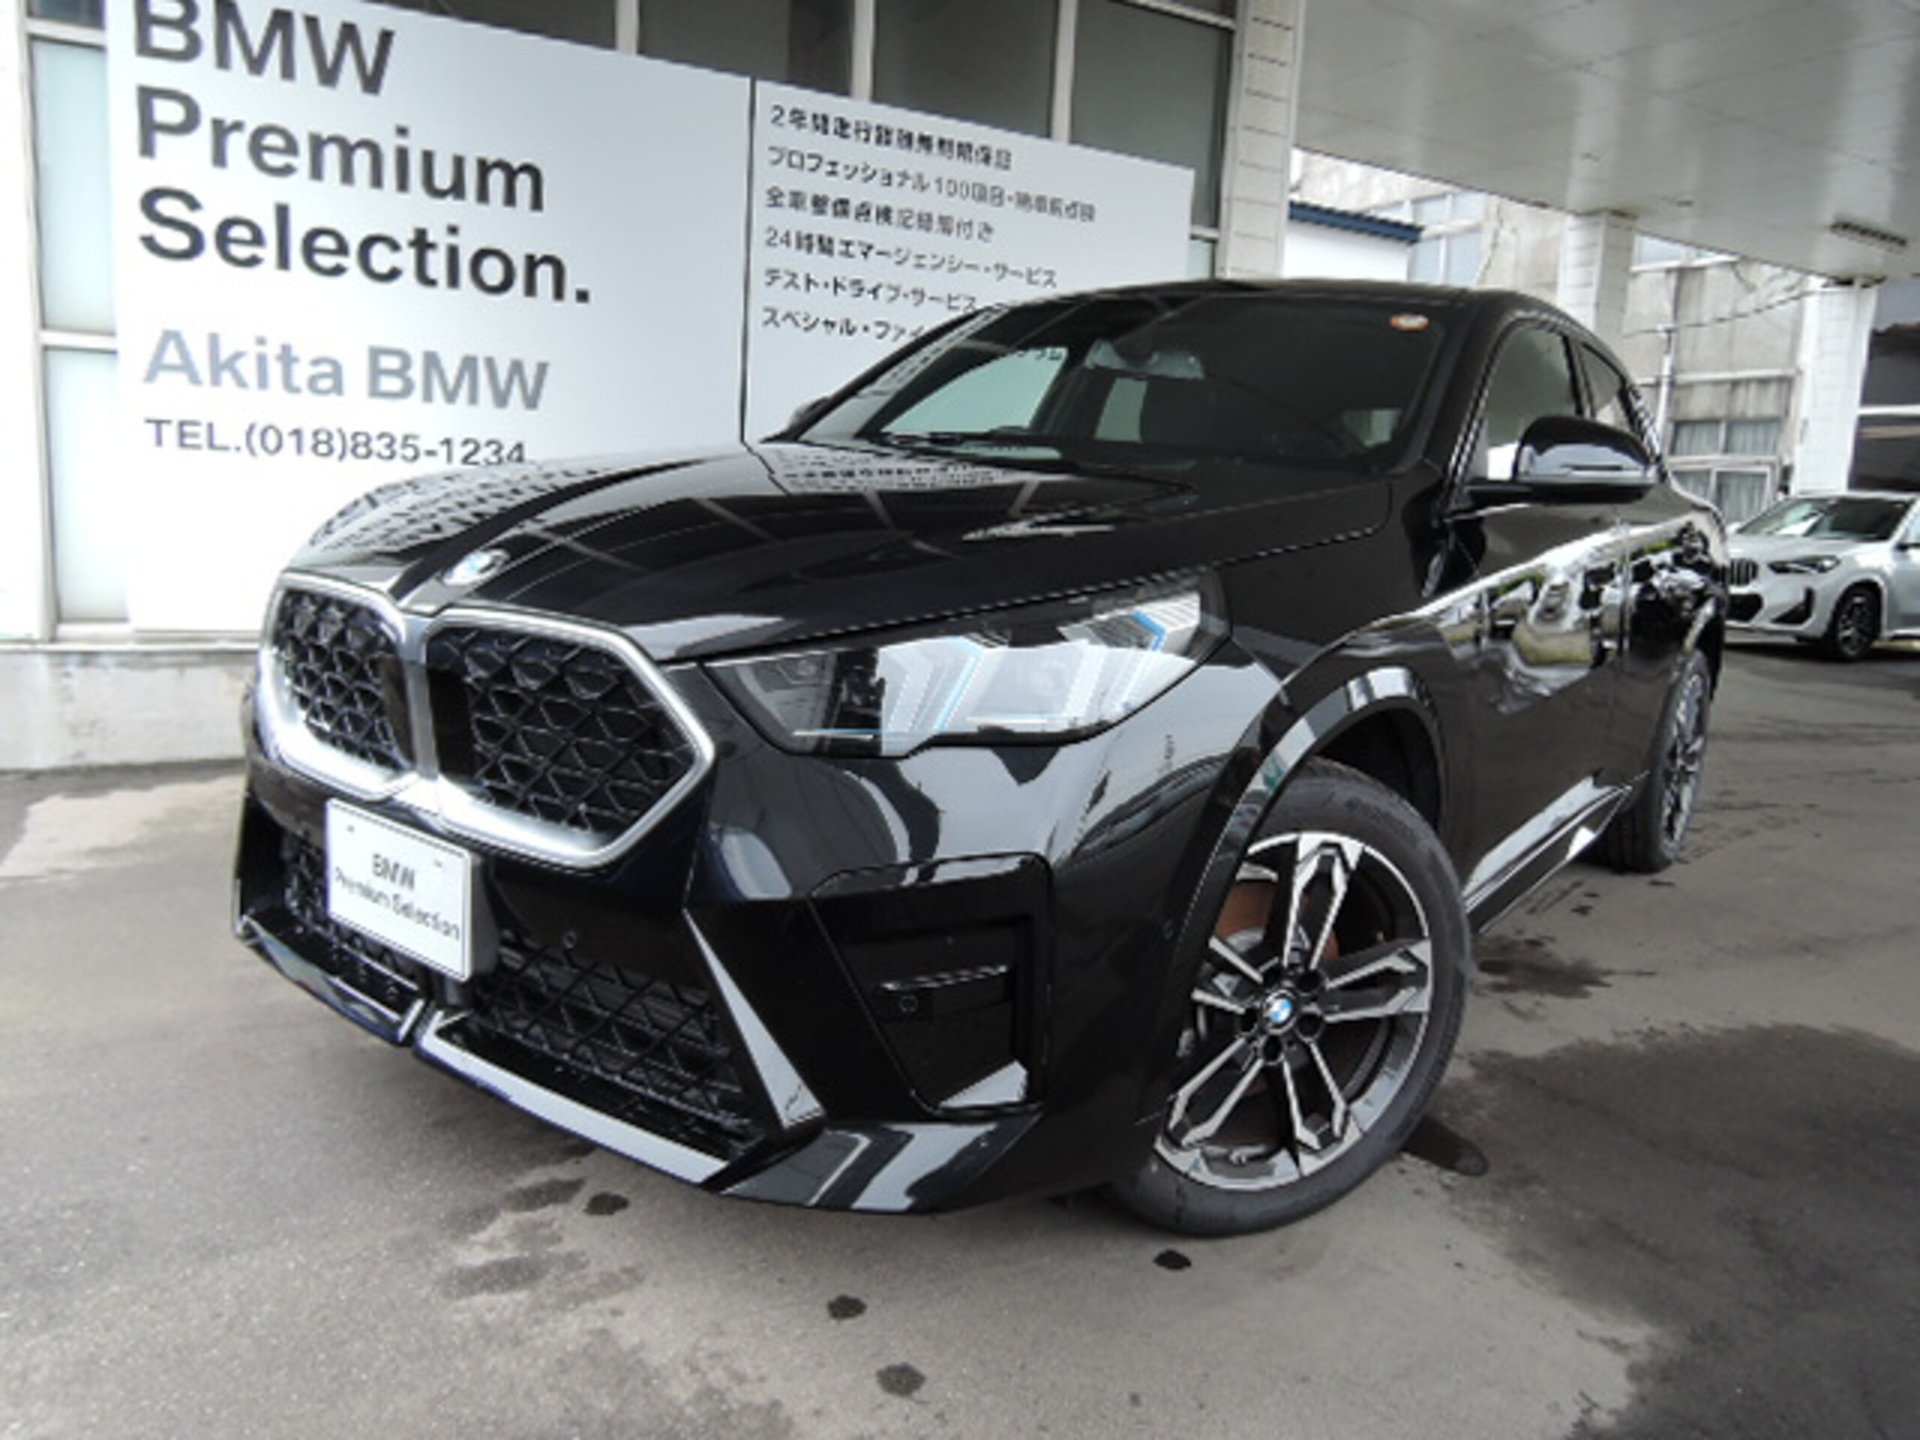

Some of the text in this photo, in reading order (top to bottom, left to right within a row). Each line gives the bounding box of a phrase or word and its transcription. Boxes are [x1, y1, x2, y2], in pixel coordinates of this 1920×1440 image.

[134, 0, 394, 95] BMW
[136, 84, 544, 212] Premium
[139, 186, 590, 304] Selection.
[143, 329, 550, 411] Akita BMW
[145, 418, 525, 466] TEL.(018)835-1234
